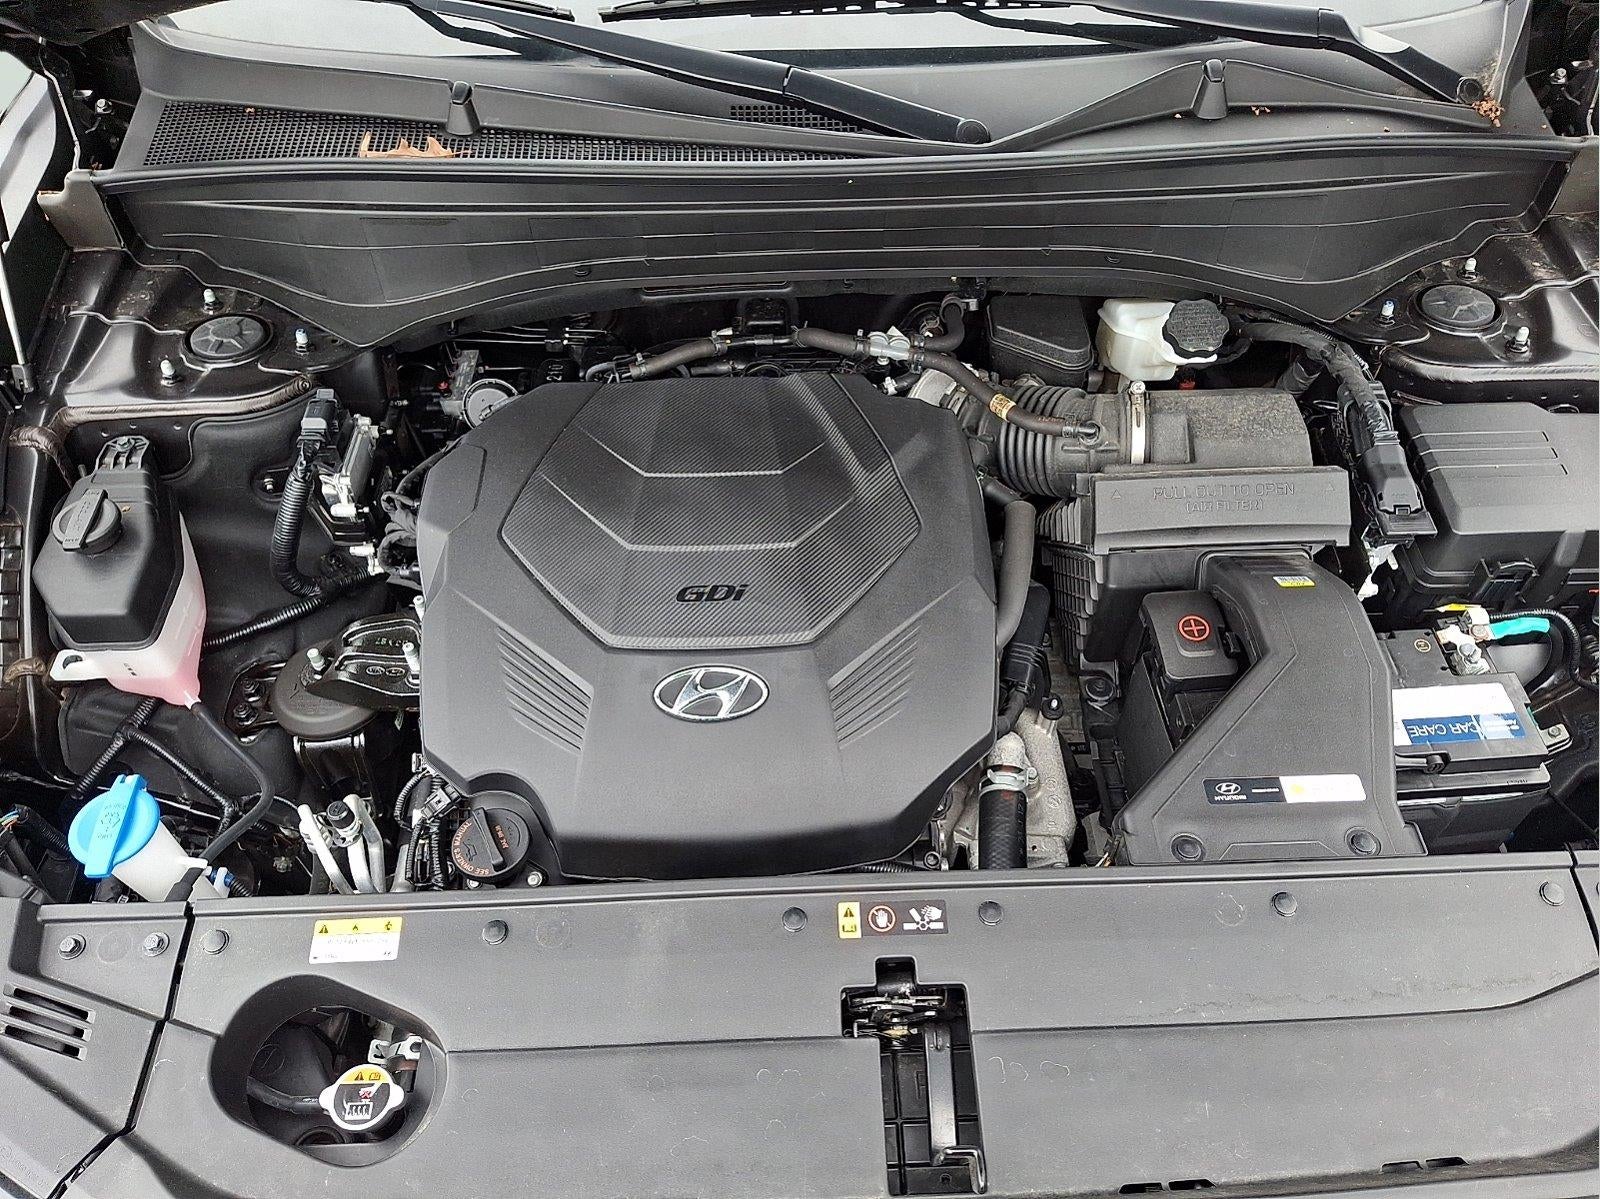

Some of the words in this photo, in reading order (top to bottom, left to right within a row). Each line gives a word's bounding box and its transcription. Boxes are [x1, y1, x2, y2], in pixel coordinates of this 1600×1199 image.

[1154, 484, 1191, 500] PULL
[1196, 484, 1227, 498] OUT
[1230, 484, 1250, 497] TO
[1255, 481, 1295, 496] OPEN
[1406, 723, 1447, 737] CARE
[1449, 721, 1479, 734] CAR
[453, 821, 473, 847] MANUAL
[474, 867, 490, 876] SEE
